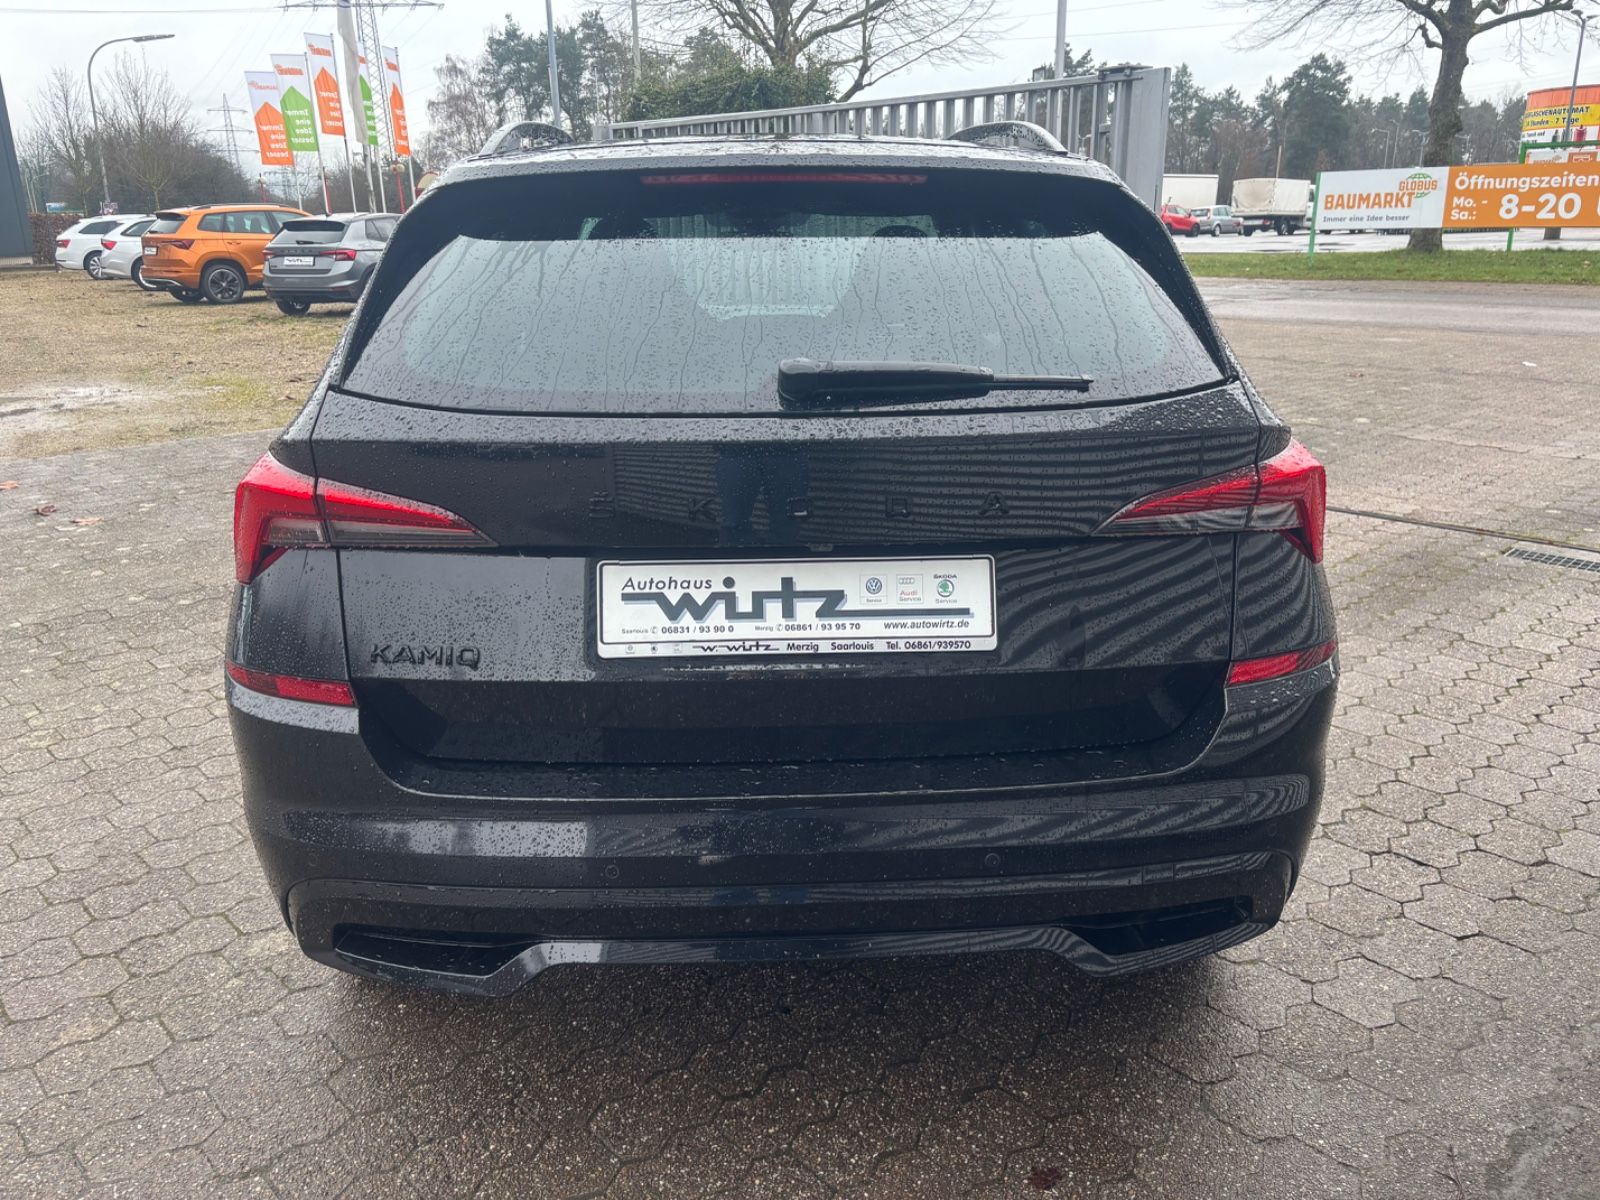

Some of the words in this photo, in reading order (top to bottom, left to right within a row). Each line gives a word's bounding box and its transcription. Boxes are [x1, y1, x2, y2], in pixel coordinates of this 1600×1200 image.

[1562, 117, 1580, 126] Tge
[1398, 180, 1438, 191] GLOBUS
[1455, 171, 1600, 192] Öffnungszeiten
[1323, 192, 1415, 210] BAUMARKT
[1453, 196, 1476, 208] Mo.
[1498, 192, 1582, 220] 8-20
[1322, 215, 1346, 223] Immer
[1385, 214, 1410, 222] besser
[1450, 209, 1477, 221] Sa.:
[621, 575, 713, 591] Autohaus
[661, 625, 690, 634] 06831
[699, 625, 711, 634] 93
[713, 624, 726, 633] 90
[784, 623, 813, 632] 06861
[820, 622, 833, 631] 93
[834, 622, 847, 631] 95
[849, 622, 861, 630] 70
[883, 619, 970, 631] www.autowirtz.de
[786, 642, 819, 652] Merzig
[830, 641, 875, 651] Saarlouis
[885, 641, 902, 650] Tel.
[904, 640, 971, 650] 06861/939570
[370, 643, 481, 671] KAMIQ
